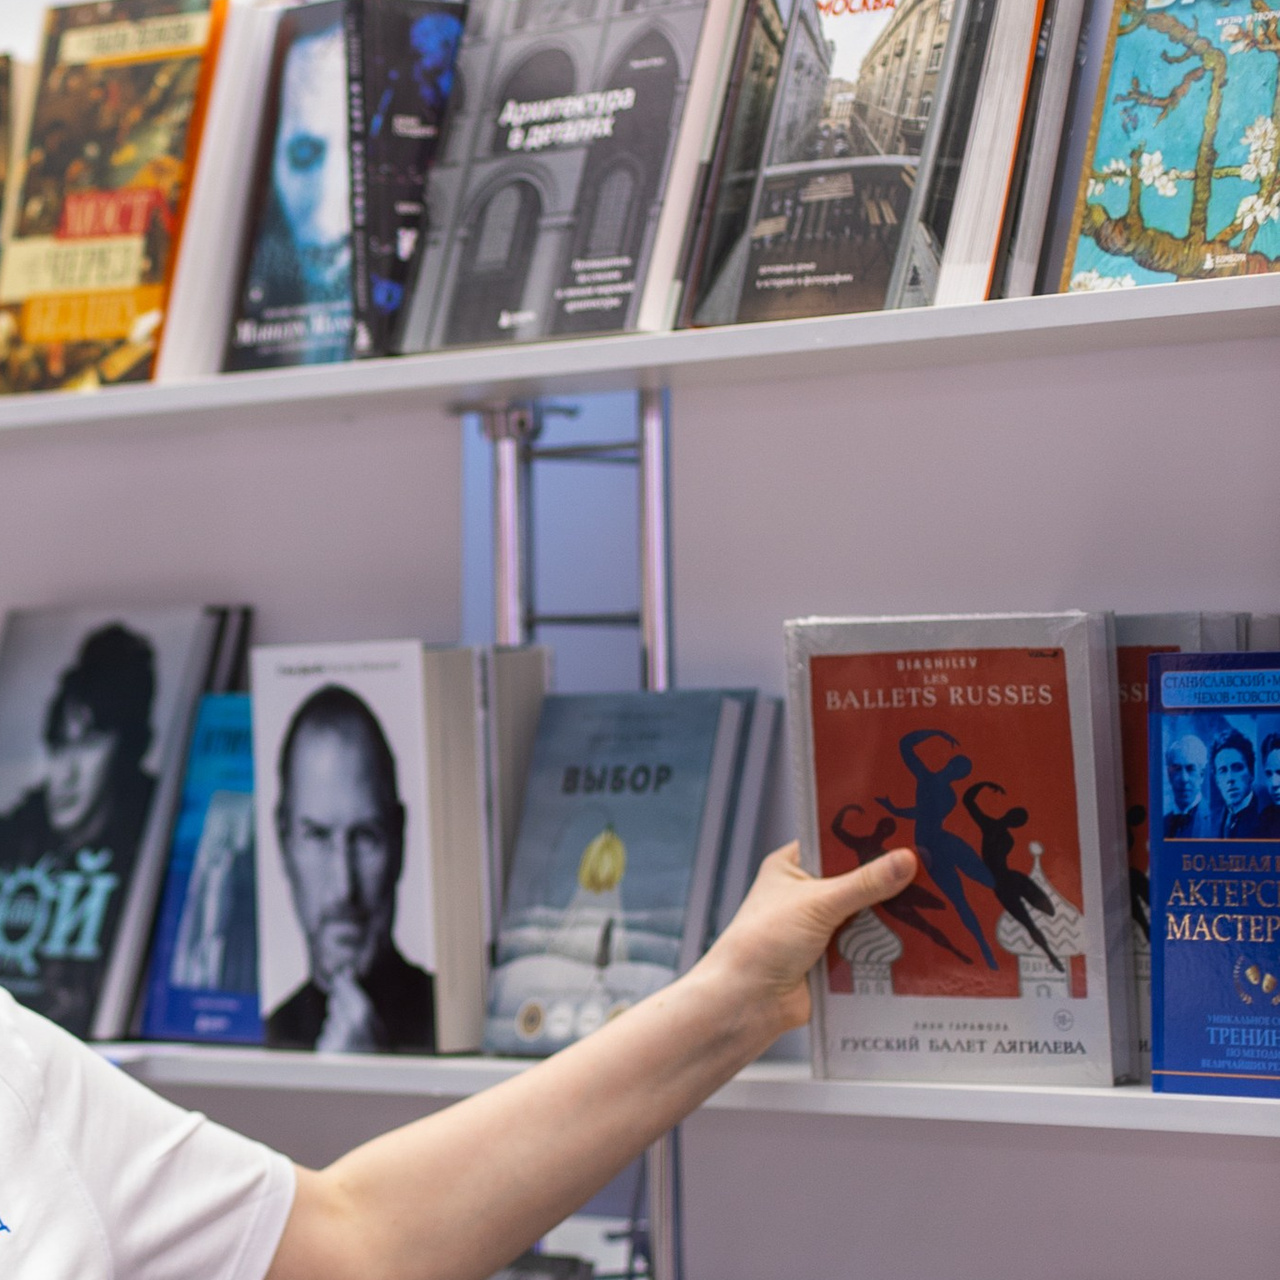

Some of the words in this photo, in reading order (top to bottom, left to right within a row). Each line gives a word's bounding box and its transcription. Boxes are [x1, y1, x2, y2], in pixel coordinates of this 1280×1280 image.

[498, 87, 637, 127] Архитектура
[523, 115, 615, 151] деталях
[896, 656, 978, 670] DIAGHILEV
[923, 672, 949, 685] LES
[1164, 672, 1266, 689] СТАНИСЛАВСКИЙ
[826, 686, 937, 710] BALLETS
[949, 684, 1053, 706] RUSSES
[562, 763, 674, 795] ВЫБОР
[1182, 854, 1271, 872] БОЛЬШАЯ
[841, 1034, 920, 1052] РУССКИЙ
[928, 1038, 988, 1053] БАЛЕТ
[993, 1038, 1088, 1055] ДЯГИЛЕВА
